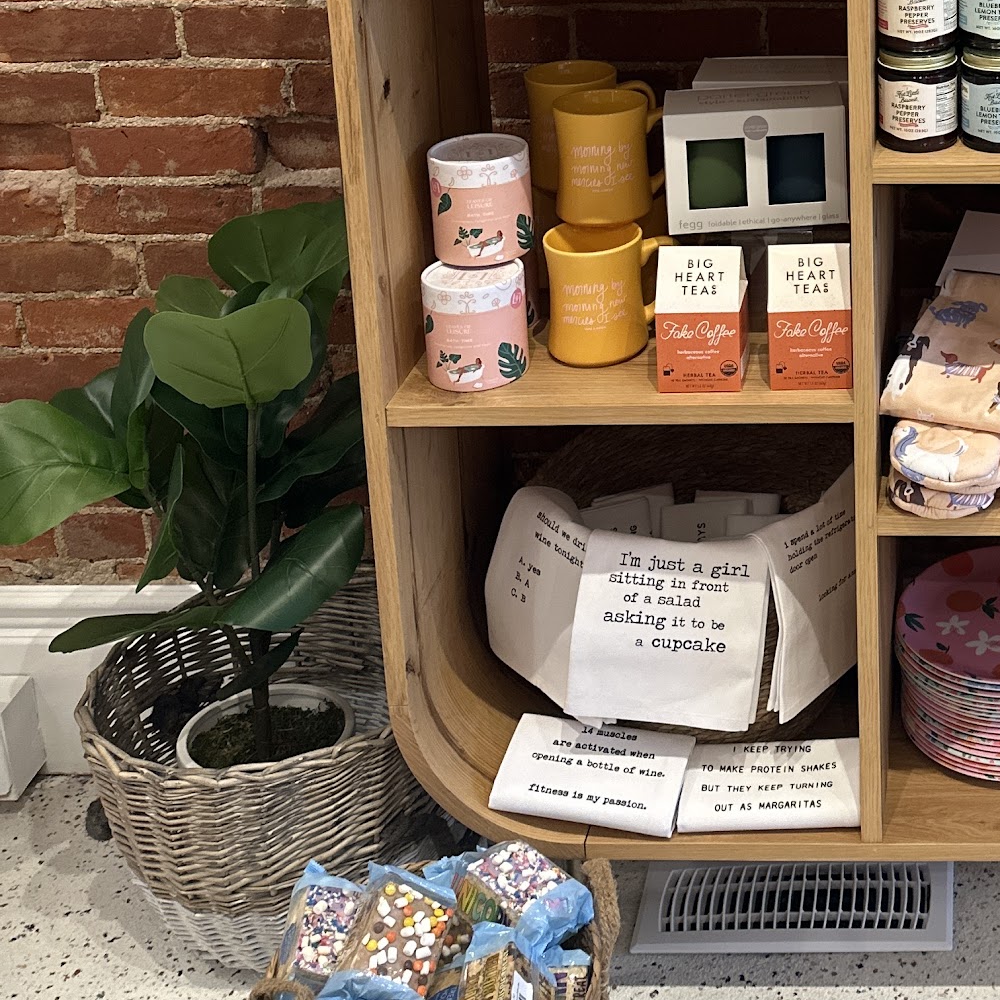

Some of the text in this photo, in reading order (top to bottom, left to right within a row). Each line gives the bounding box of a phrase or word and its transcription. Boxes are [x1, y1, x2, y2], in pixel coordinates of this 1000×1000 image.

[679, 212, 840, 230] fegg foldable ethical go-anywhere glass
[687, 258, 714, 269] BIG
[674, 271, 725, 282] HEART
[563, 280, 626, 303] morning by
[563, 301, 608, 324] morning
[661, 321, 736, 345] Fake Coffee
[536, 511, 571, 541] should we
[788, 536, 824, 561] holding the
[790, 530, 809, 547] spend
[535, 531, 584, 569] wine tonight
[528, 563, 541, 576] yes
[619, 551, 750, 579] I'm just a girl
[789, 553, 818, 574] door open
[608, 572, 729, 592] sitting in front
[623, 593, 701, 608] of a salad
[603, 610, 725, 630] asking it to be
[635, 637, 726, 653] a cupcake
[581, 726, 638, 741] 14 muscles
[553, 739, 655, 760] are activated when
[743, 745, 769, 753] KEEP
[775, 745, 812, 753] TRYING
[532, 752, 665, 778] opening a bottle of wine.
[701, 761, 837, 773] TO MAKE PROTEIN SHAKES
[528, 783, 647, 810] fitness is my passion.
[701, 784, 720, 792] BUT
[758, 783, 783, 791] KEEP
[790, 781, 833, 790] TURNING
[714, 800, 822, 812] OUT AS MARGARITAS
